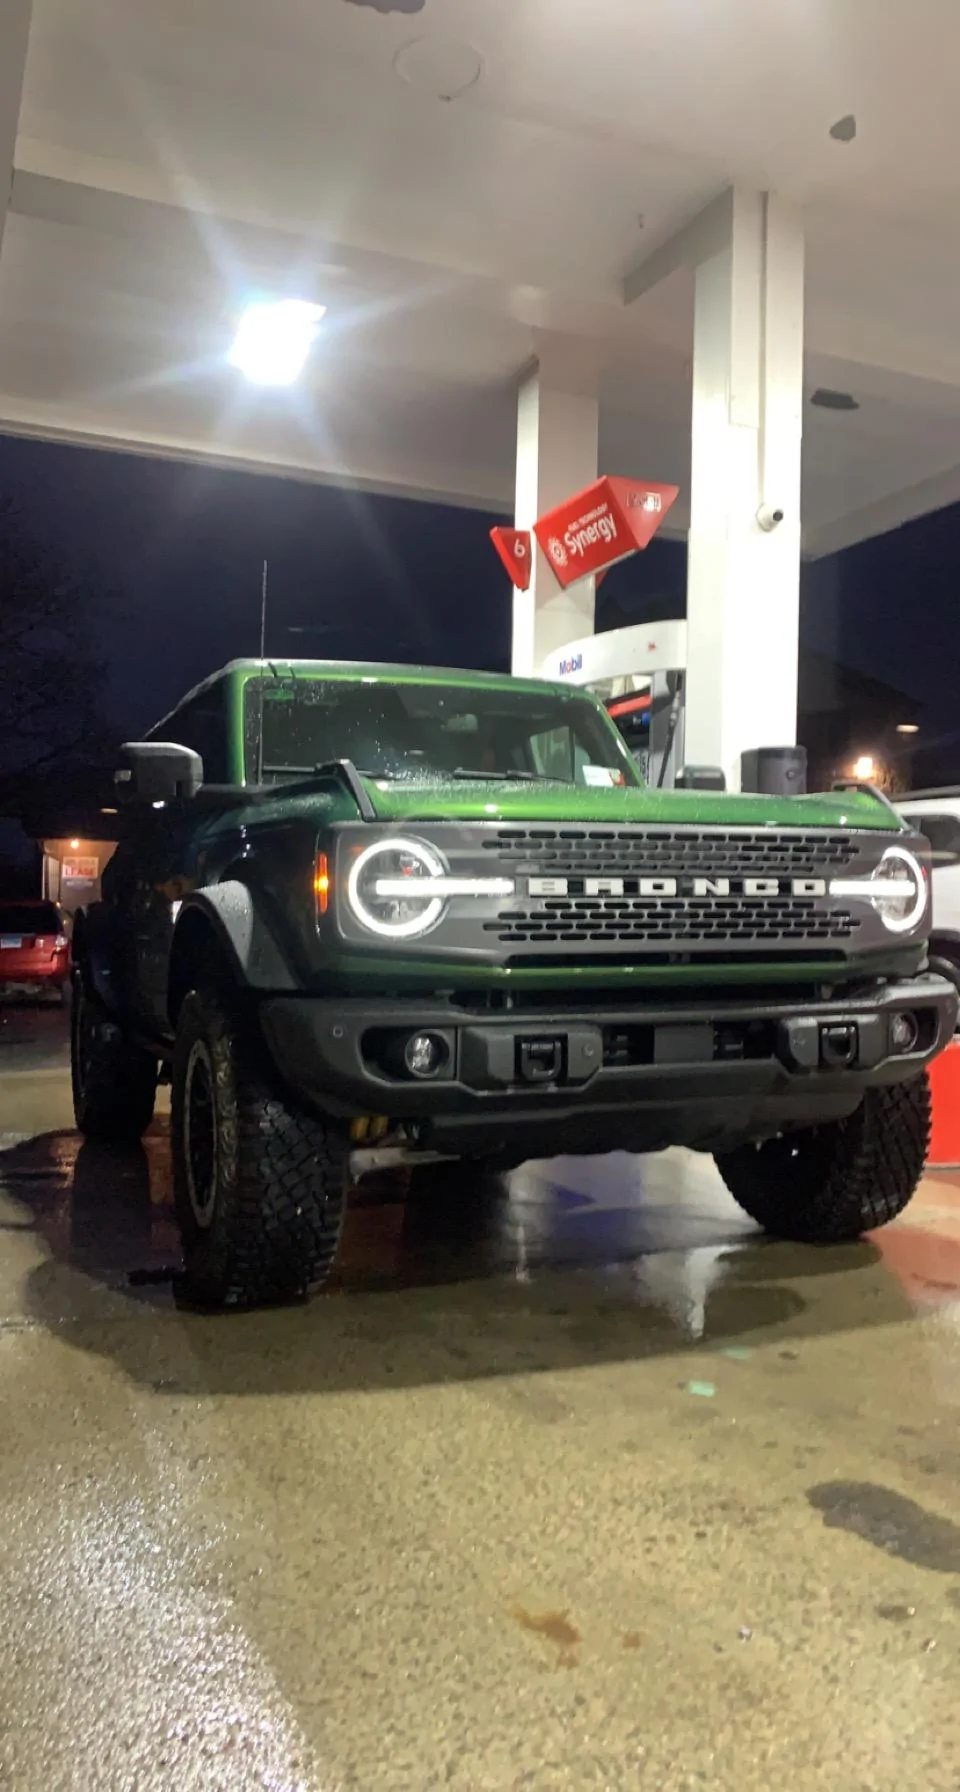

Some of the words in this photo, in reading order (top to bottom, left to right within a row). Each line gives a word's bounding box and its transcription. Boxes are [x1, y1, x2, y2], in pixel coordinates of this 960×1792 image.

[563, 512, 618, 558] Synergy
[514, 538, 526, 558] 6
[559, 653, 583, 676] Mobil
[528, 877, 826, 898] BRONCO
